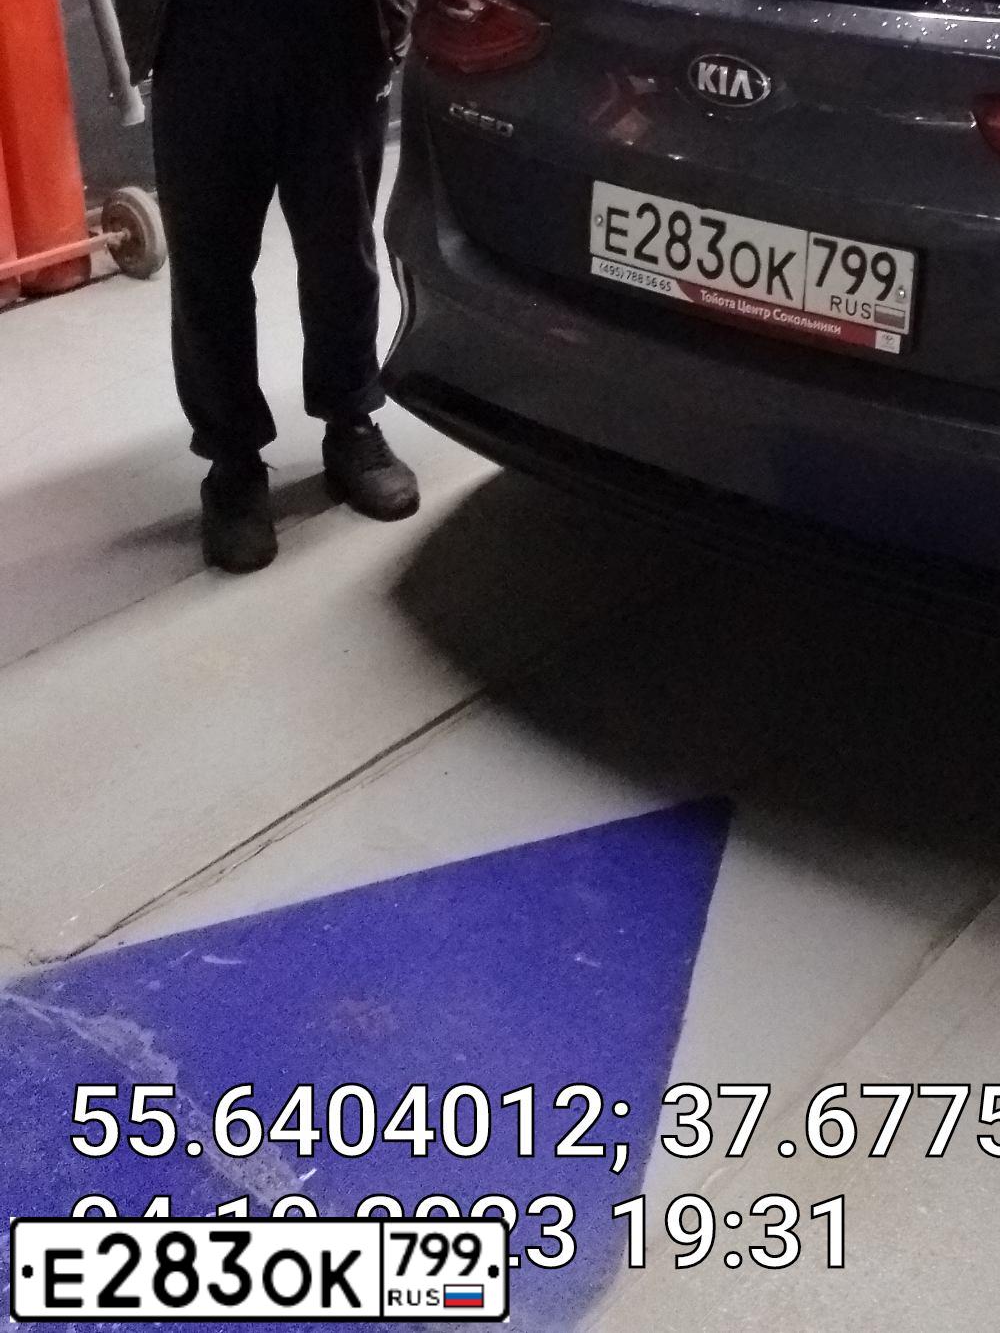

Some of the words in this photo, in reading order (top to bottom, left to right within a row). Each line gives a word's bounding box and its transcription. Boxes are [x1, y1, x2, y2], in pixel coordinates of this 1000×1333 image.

[698, 62, 754, 100] KIA
[813, 238, 897, 301] 799
[700, 289, 736, 310] Тойота
[737, 299, 771, 320] Центр
[772, 308, 842, 335] Сокольники
[830, 295, 873, 320] RUS
